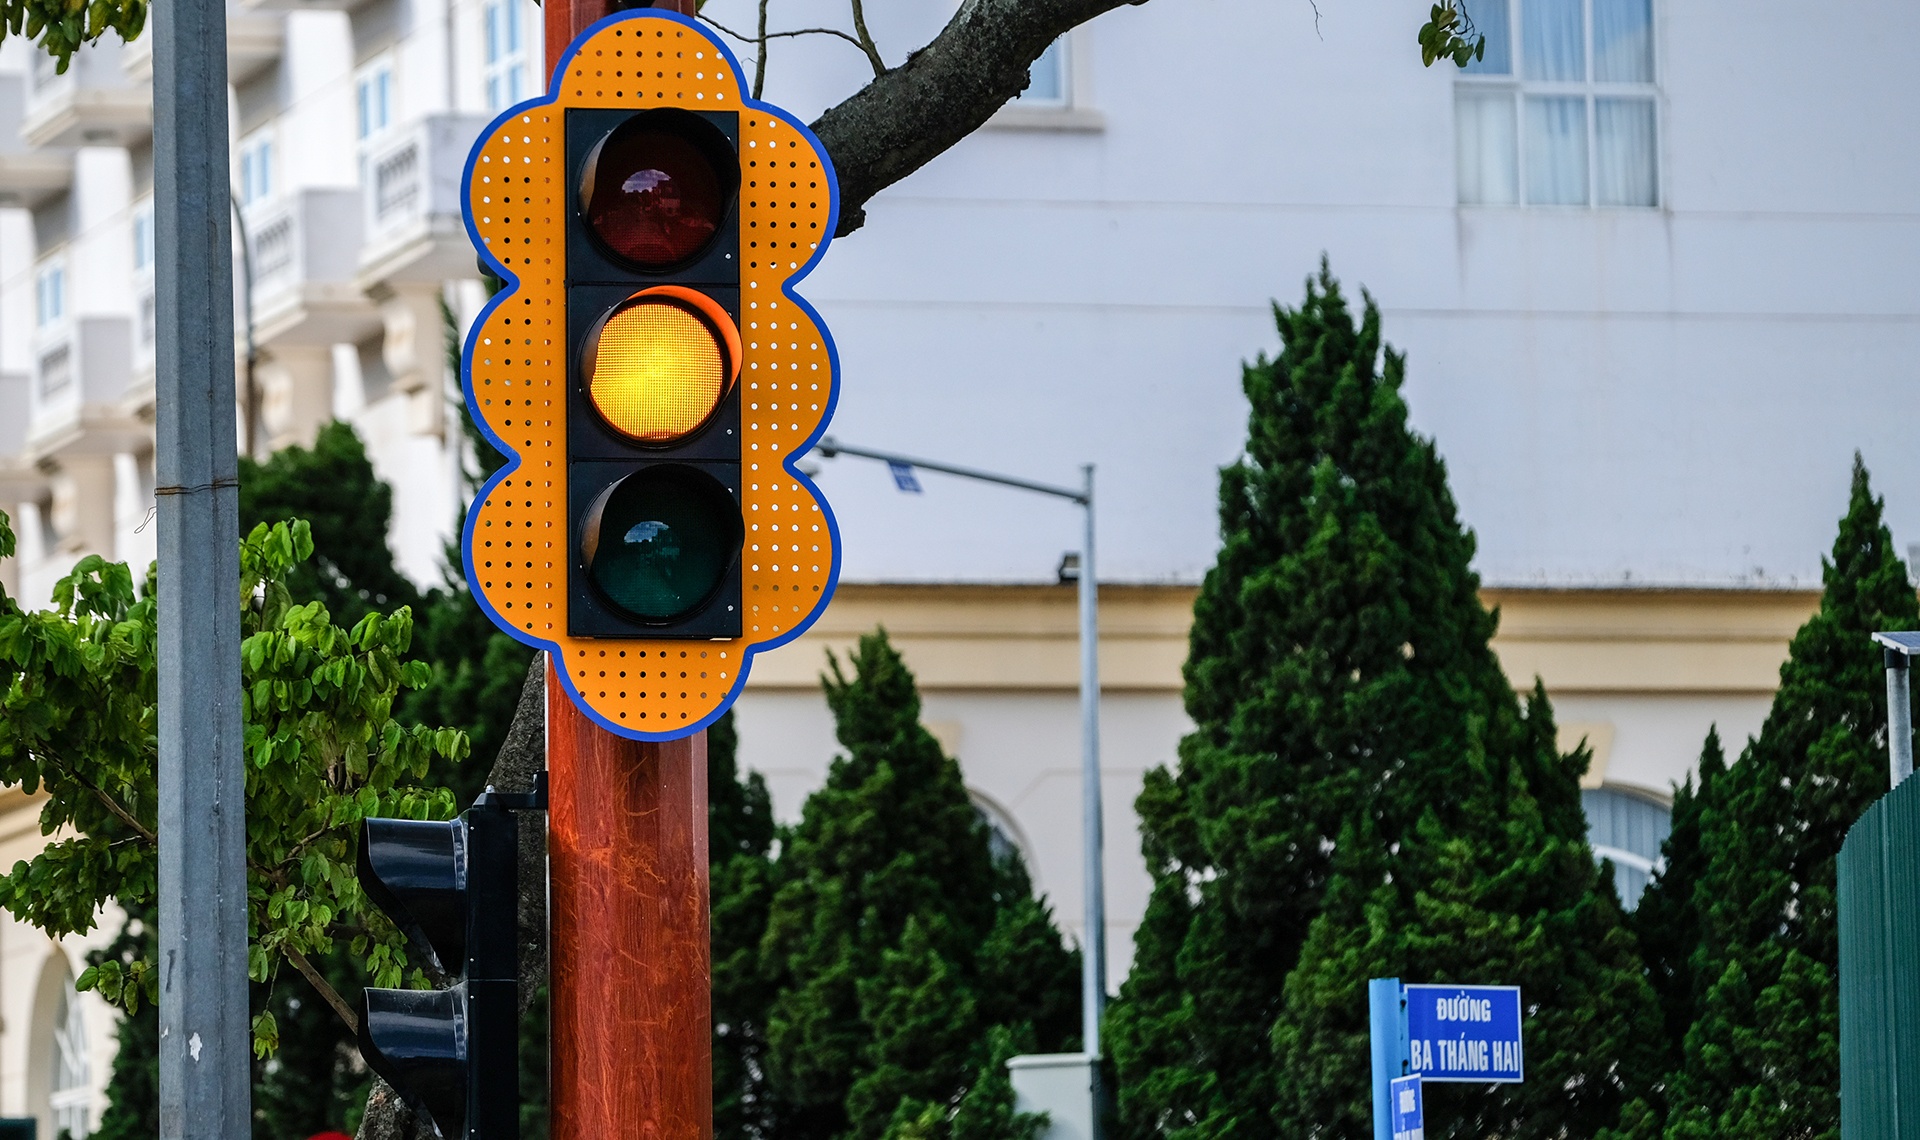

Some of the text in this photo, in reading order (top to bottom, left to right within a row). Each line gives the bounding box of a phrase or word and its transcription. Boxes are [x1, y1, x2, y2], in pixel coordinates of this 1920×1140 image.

[1436, 990, 1491, 1022] ĐƯỜNG
[1411, 1032, 1518, 1073] BA THÁNG HAI
